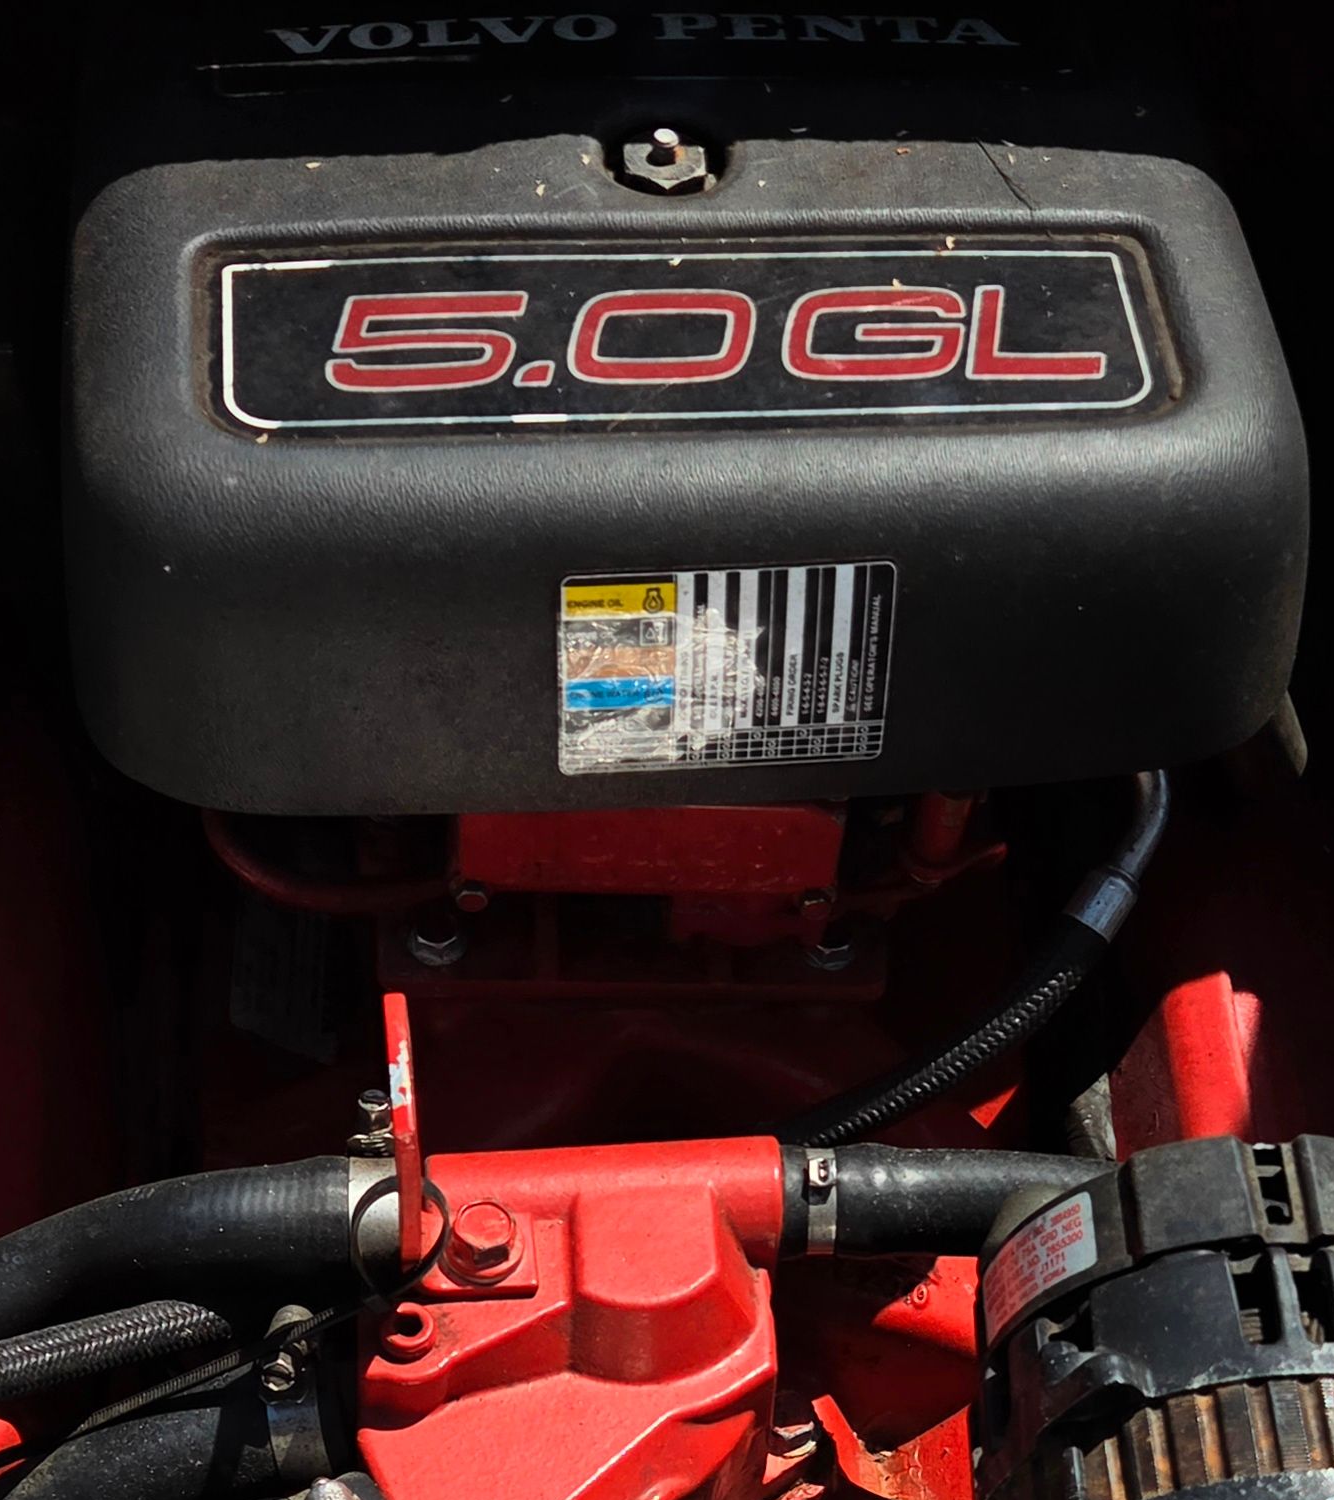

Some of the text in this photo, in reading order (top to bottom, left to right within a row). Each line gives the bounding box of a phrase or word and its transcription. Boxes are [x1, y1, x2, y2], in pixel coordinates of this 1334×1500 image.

[267, 12, 1021, 54] VOLVO PENTA
[567, 599, 624, 609] ENGINE OIL
[863, 694, 874, 711] SEE
[869, 594, 882, 632] MANUAL
[786, 653, 798, 715] FIRING ORDER
[832, 650, 844, 713] SPARK PLUGS
[1062, 1216, 1082, 1233] NEG
